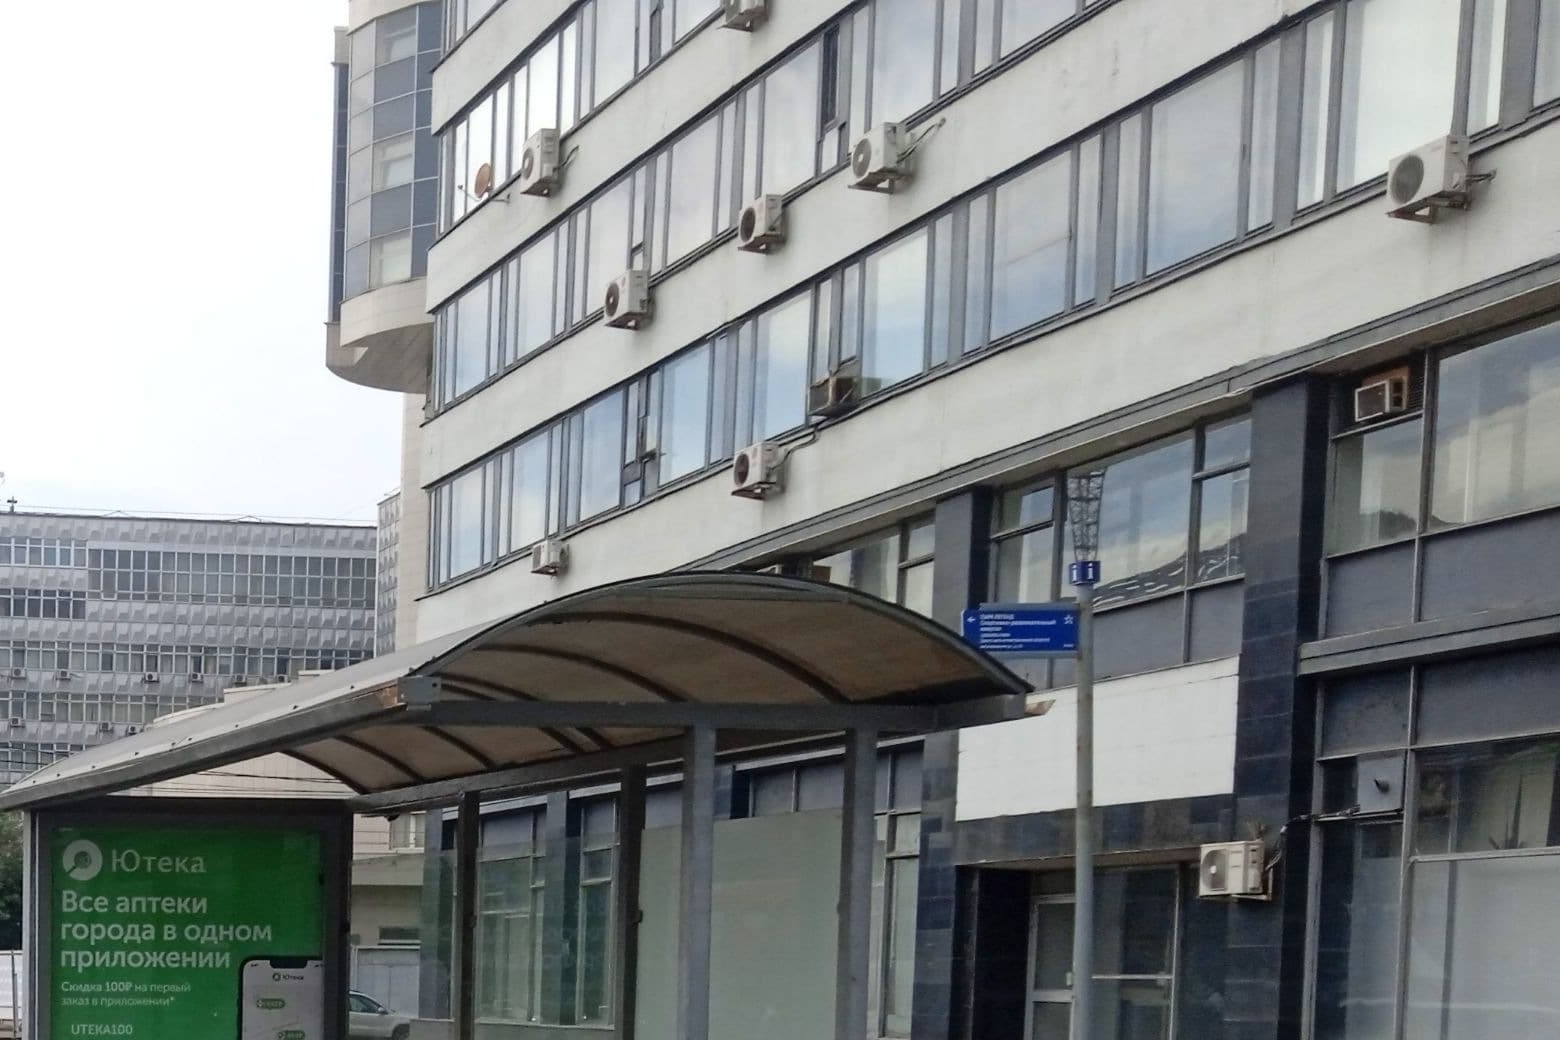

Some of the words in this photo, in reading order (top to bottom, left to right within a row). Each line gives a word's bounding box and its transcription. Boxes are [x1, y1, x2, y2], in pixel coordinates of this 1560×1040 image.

[111, 848, 206, 873] Ютека
[61, 890, 108, 913] Все
[116, 896, 208, 914] аптеки
[60, 922, 155, 945] города
[163, 924, 177, 940] в
[184, 925, 272, 944] одном
[60, 950, 230, 972] приложении
[61, 981, 102, 993] Скидка
[134, 984, 148, 992] на
[150, 982, 192, 994] первый
[71, 1024, 134, 1036] UTEKA100
